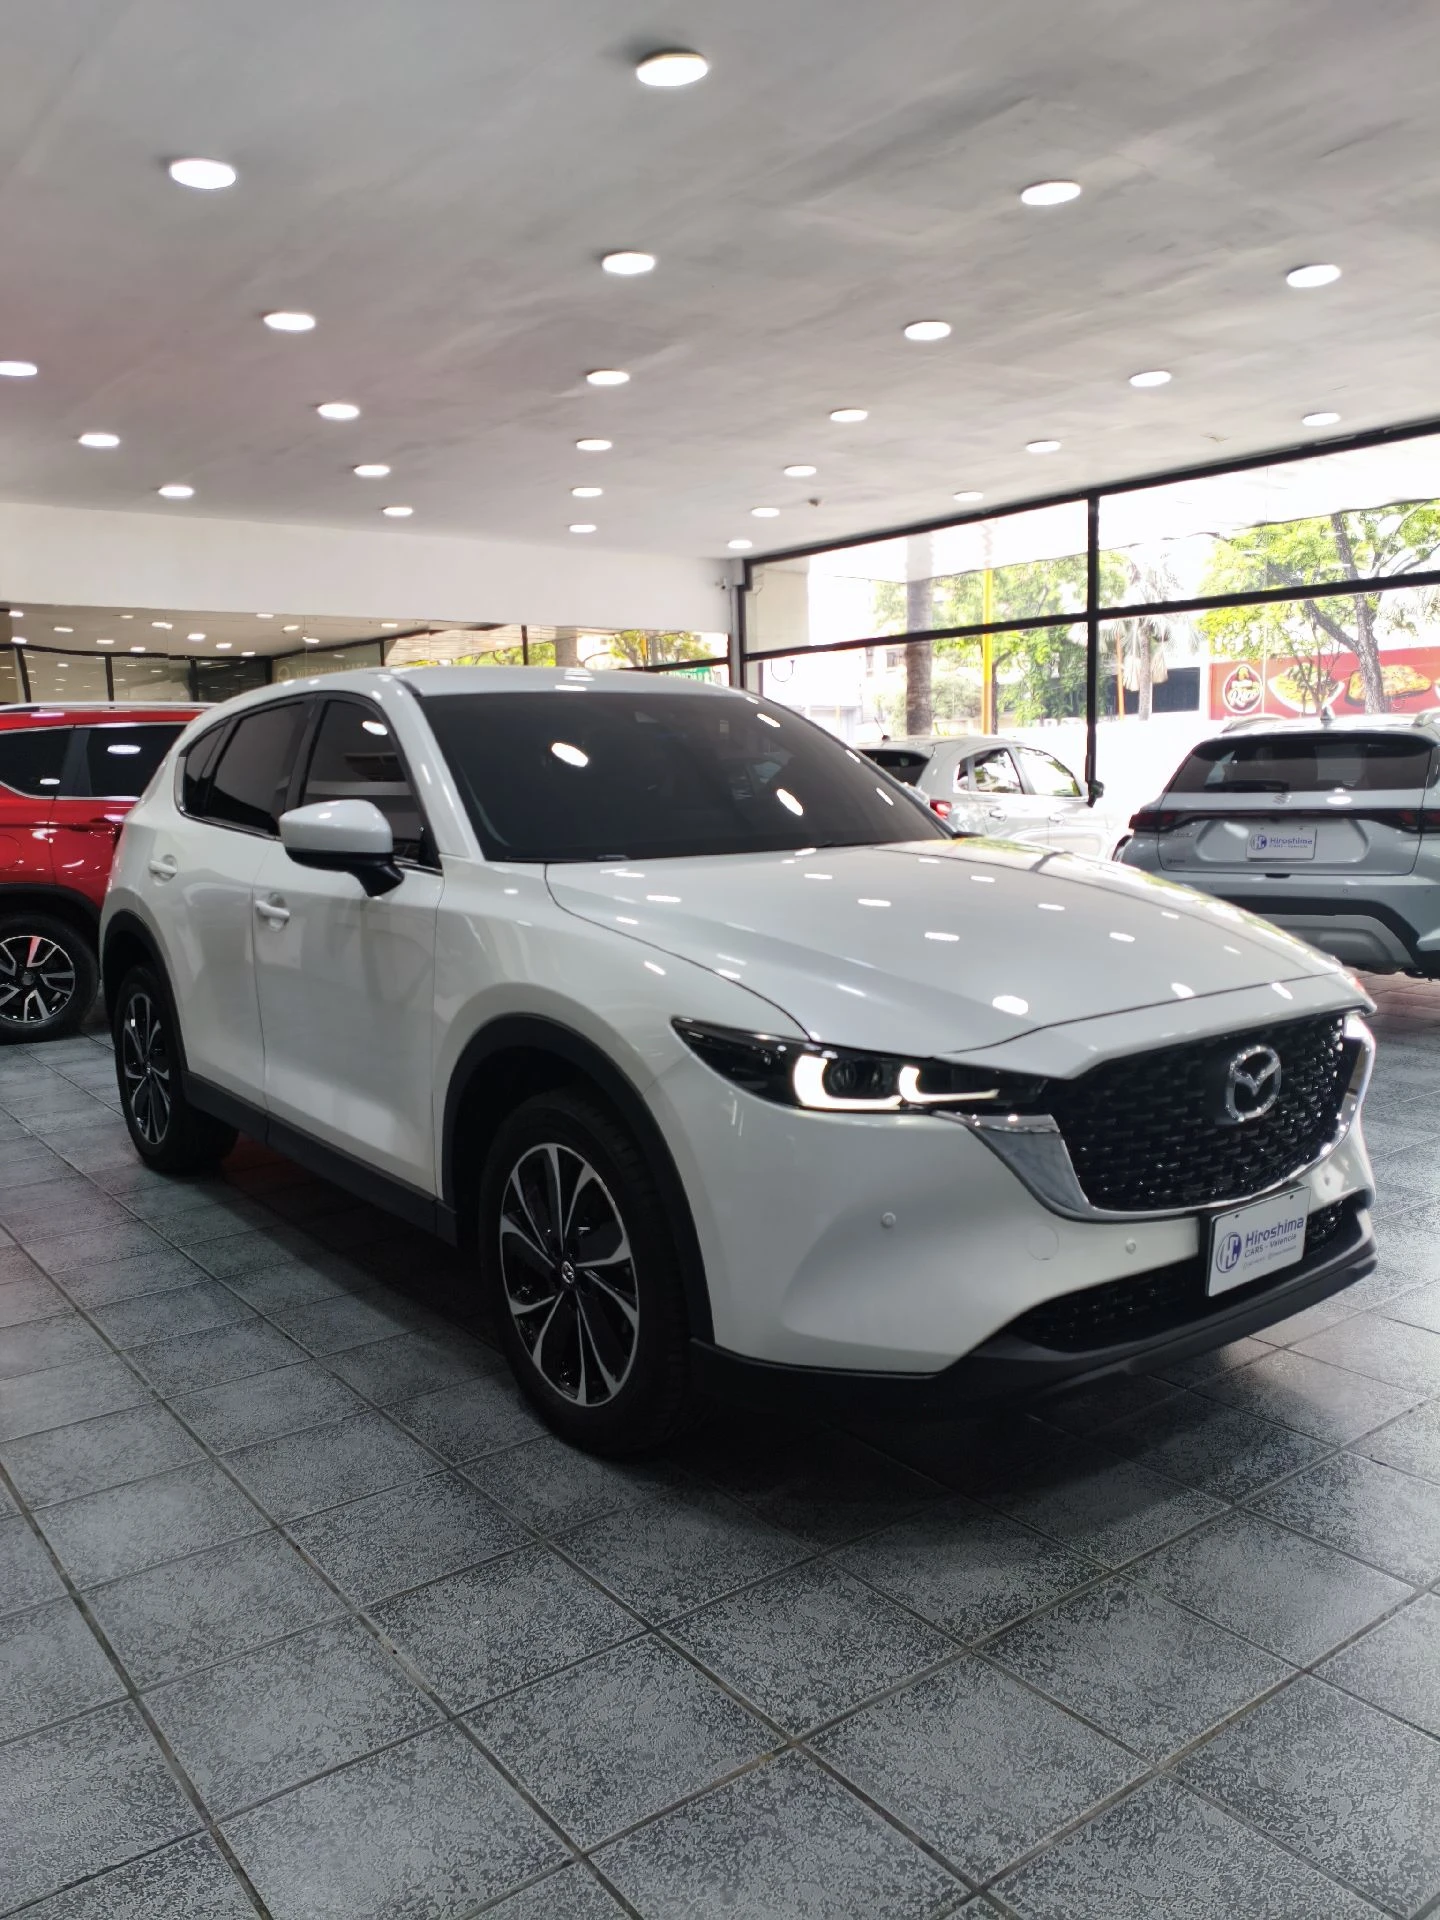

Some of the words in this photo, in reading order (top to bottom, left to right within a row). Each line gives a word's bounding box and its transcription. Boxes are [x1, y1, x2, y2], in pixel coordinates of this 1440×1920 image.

[1270, 837, 1313, 845] Hiroshima
[1245, 1217, 1304, 1248] Hiroshima
[1244, 1244, 1264, 1258] CARS
[1270, 1233, 1297, 1248] Valencia
